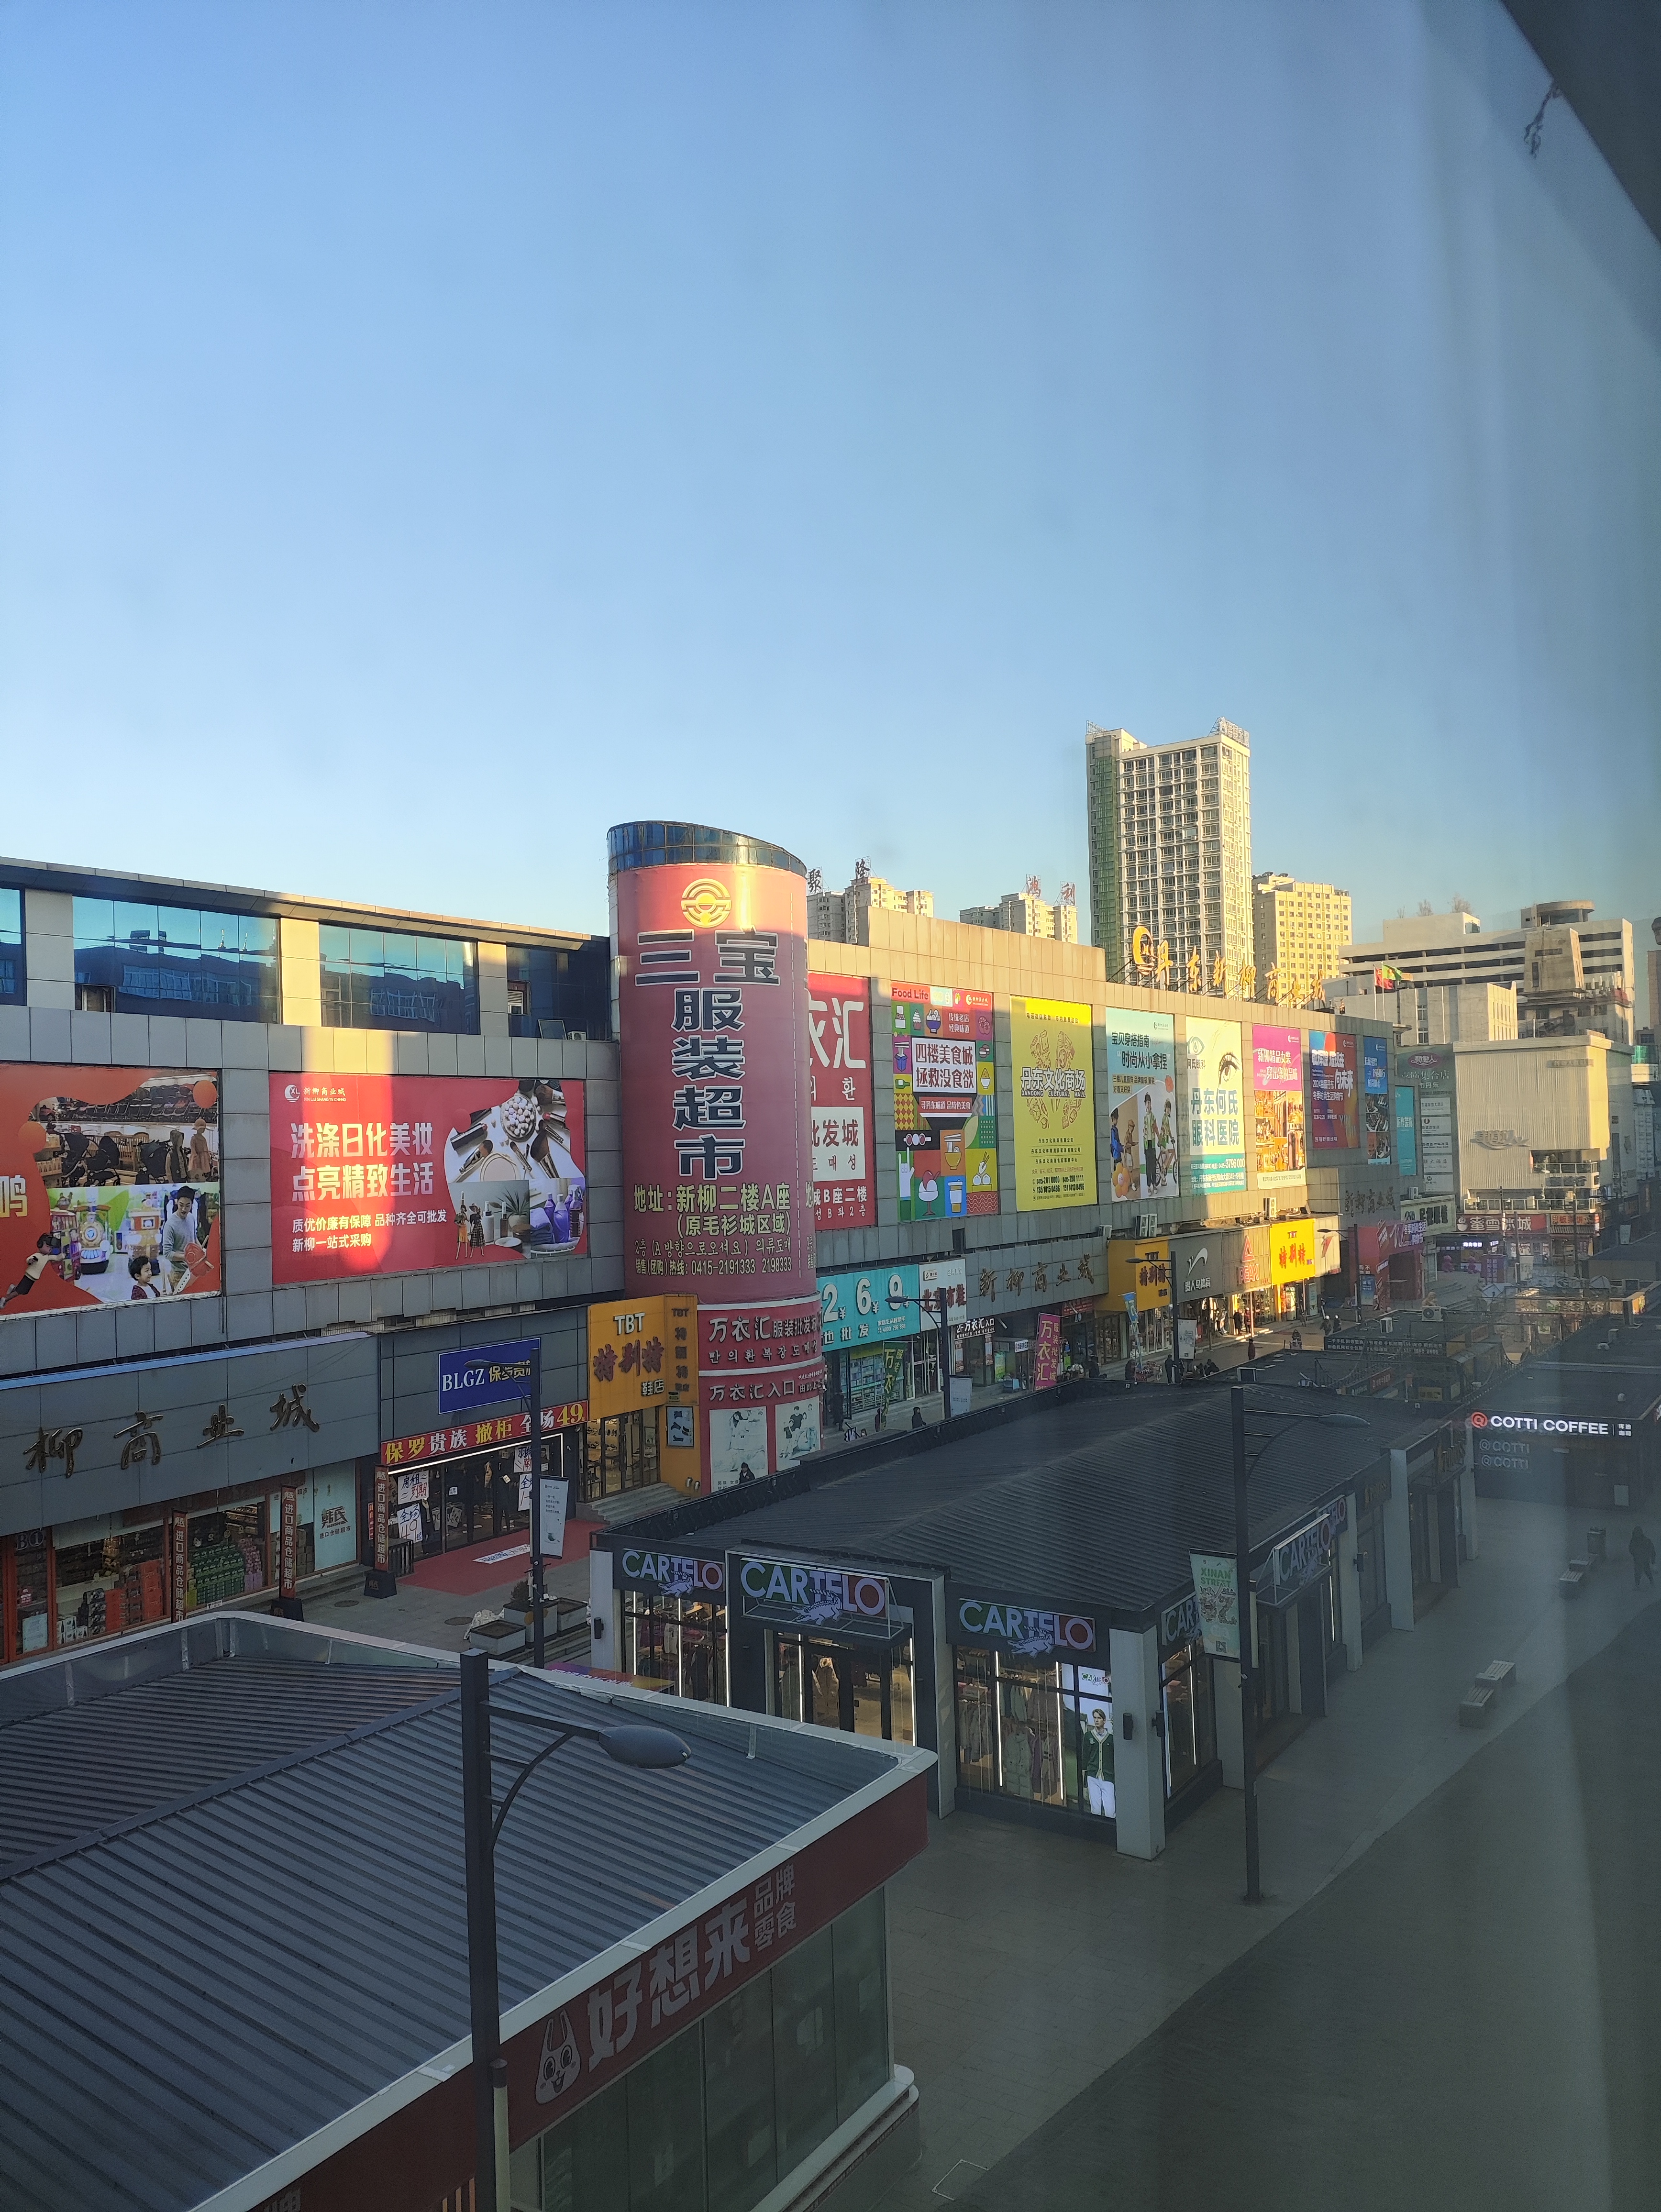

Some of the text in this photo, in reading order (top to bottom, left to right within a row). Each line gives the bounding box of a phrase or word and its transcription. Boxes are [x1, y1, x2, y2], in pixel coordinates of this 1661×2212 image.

[635, 925, 780, 986] 三宝
[892, 987, 929, 1000] Food Life
[949, 1012, 969, 1023] 传统老店
[949, 1023, 970, 1033] 经典味道
[1111, 1031, 1150, 1048] 宝贝穿搭指南
[915, 1043, 973, 1066] 四楼美食城
[1187, 1059, 1206, 1070] 何氏眼科
[1258, 1049, 1291, 1064] 新柳精品女装
[671, 987, 747, 1181] 服装超市
[916, 1067, 974, 1089] 拯救没食欲
[1021, 1067, 1085, 1091] 丹东文化商场
[1267, 1066, 1298, 1080] 穿出您的品味
[303, 1087, 345, 1096] 新柳商业城
[1191, 1088, 1238, 1116] 丹东何氏
[290, 1122, 433, 1158] 洗涤日化美妆
[1192, 1119, 1239, 1147] 眼科医院
[292, 1162, 434, 1202] 点亮精致生活
[292, 1209, 447, 1234] 质优价廉有保障 品种齐全可批发
[1470, 1216, 1532, 1231] 蜜雪冰城
[292, 1233, 372, 1252] 新柳一站式采购
[691, 1258, 756, 1276] 0415-2191333
[762, 1256, 792, 1273] 2198333
[1238, 1263, 1259, 1285] PEAK
[980, 1254, 1094, 1302] 新柳商业城
[1185, 1277, 1211, 1292] 贵人鸟体育
[613, 1312, 645, 1335] TBT
[823, 1324, 869, 1345] 也批发
[443, 1368, 485, 1392] BLGZ
[641, 1379, 664, 1396] 鞋店
[1491, 1415, 1609, 1435] COTTI COFFEE
[385, 1429, 467, 1465] 保罗贵族
[475, 1418, 513, 1444] 撤柜
[1493, 1441, 1529, 1454] COTTI
[402, 1474, 421, 1490] 房租
[411, 1482, 427, 1499] 到期
[377, 1483, 386, 1564] 进口商品仓储超市
[400, 1505, 420, 1525] 全场
[319, 1526, 351, 1539] 进口仓储超市
[284, 1503, 294, 1590] 进口商品仓储超市
[622, 1548, 723, 1592] CARTELO
[1200, 1567, 1231, 1580] XINAN
[741, 1560, 886, 1616] CARTELO
[1201, 1577, 1231, 1587] STREET
[960, 1600, 1094, 1651] CARTELO
[754, 1864, 795, 1915] 品牌
[754, 1901, 797, 1952] 零食
[587, 1897, 750, 2073] 好想来
